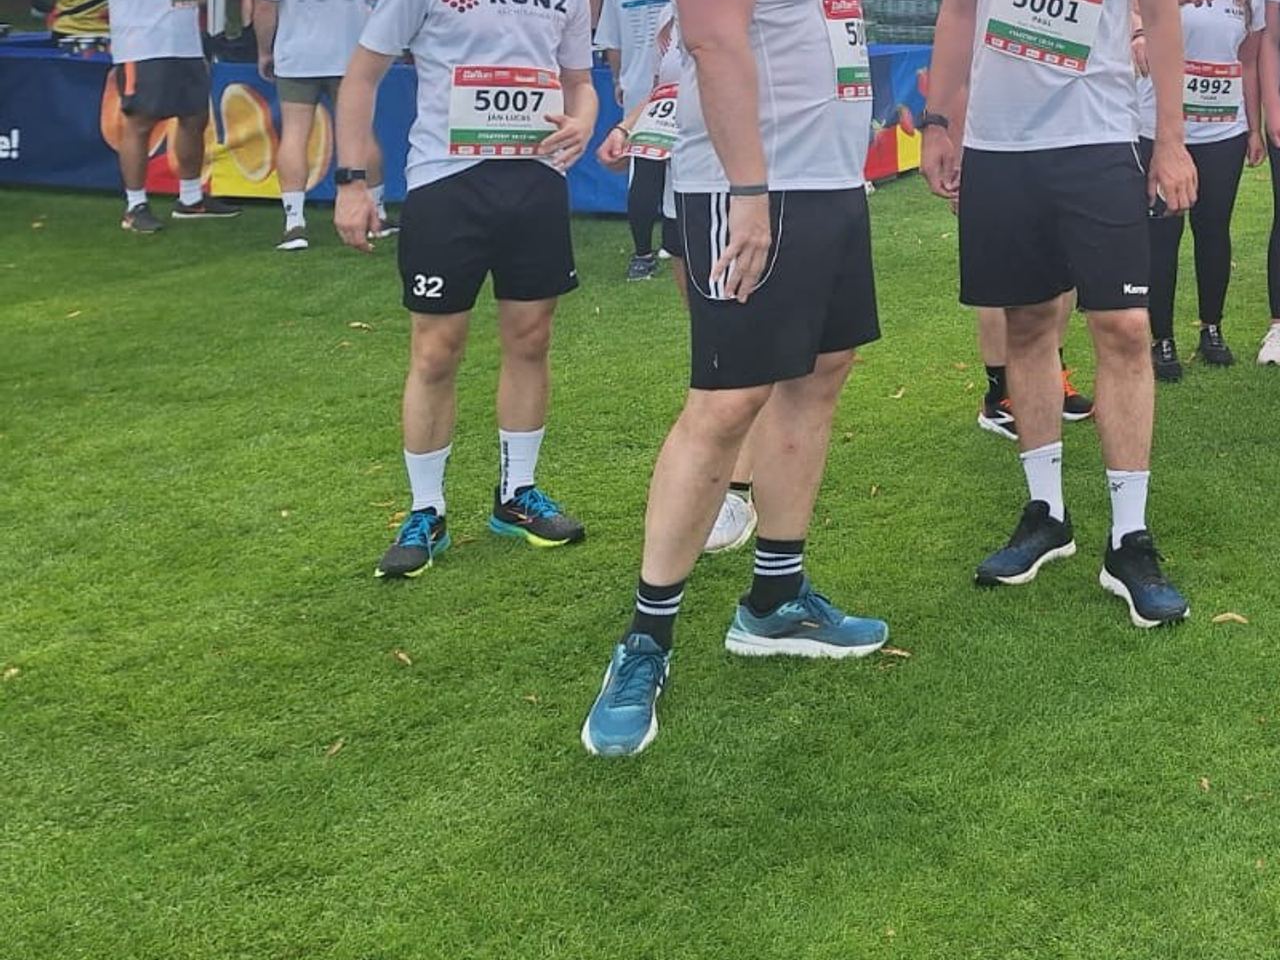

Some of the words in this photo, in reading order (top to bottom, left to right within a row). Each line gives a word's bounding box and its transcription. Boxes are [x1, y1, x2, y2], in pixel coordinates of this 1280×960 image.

[1187, 78, 1232, 94] 4992
[474, 90, 545, 112] 5007
[413, 274, 444, 298] 32
